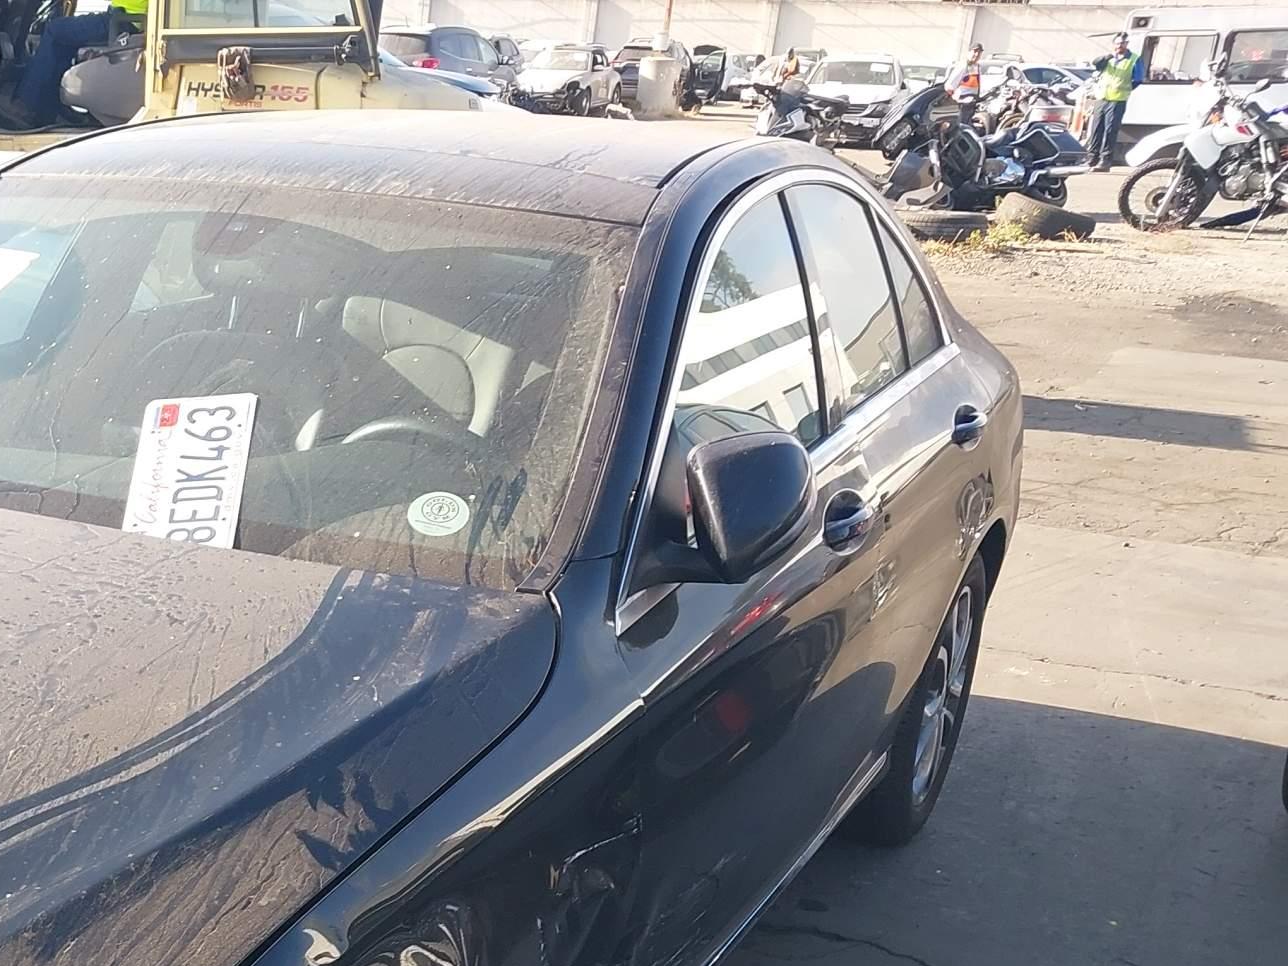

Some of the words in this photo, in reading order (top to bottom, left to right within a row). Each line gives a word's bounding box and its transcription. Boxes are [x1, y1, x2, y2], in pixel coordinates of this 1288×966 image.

[187, 81, 266, 100] HYSR
[133, 430, 172, 524] California
[166, 405, 237, 544] 8EDK463
